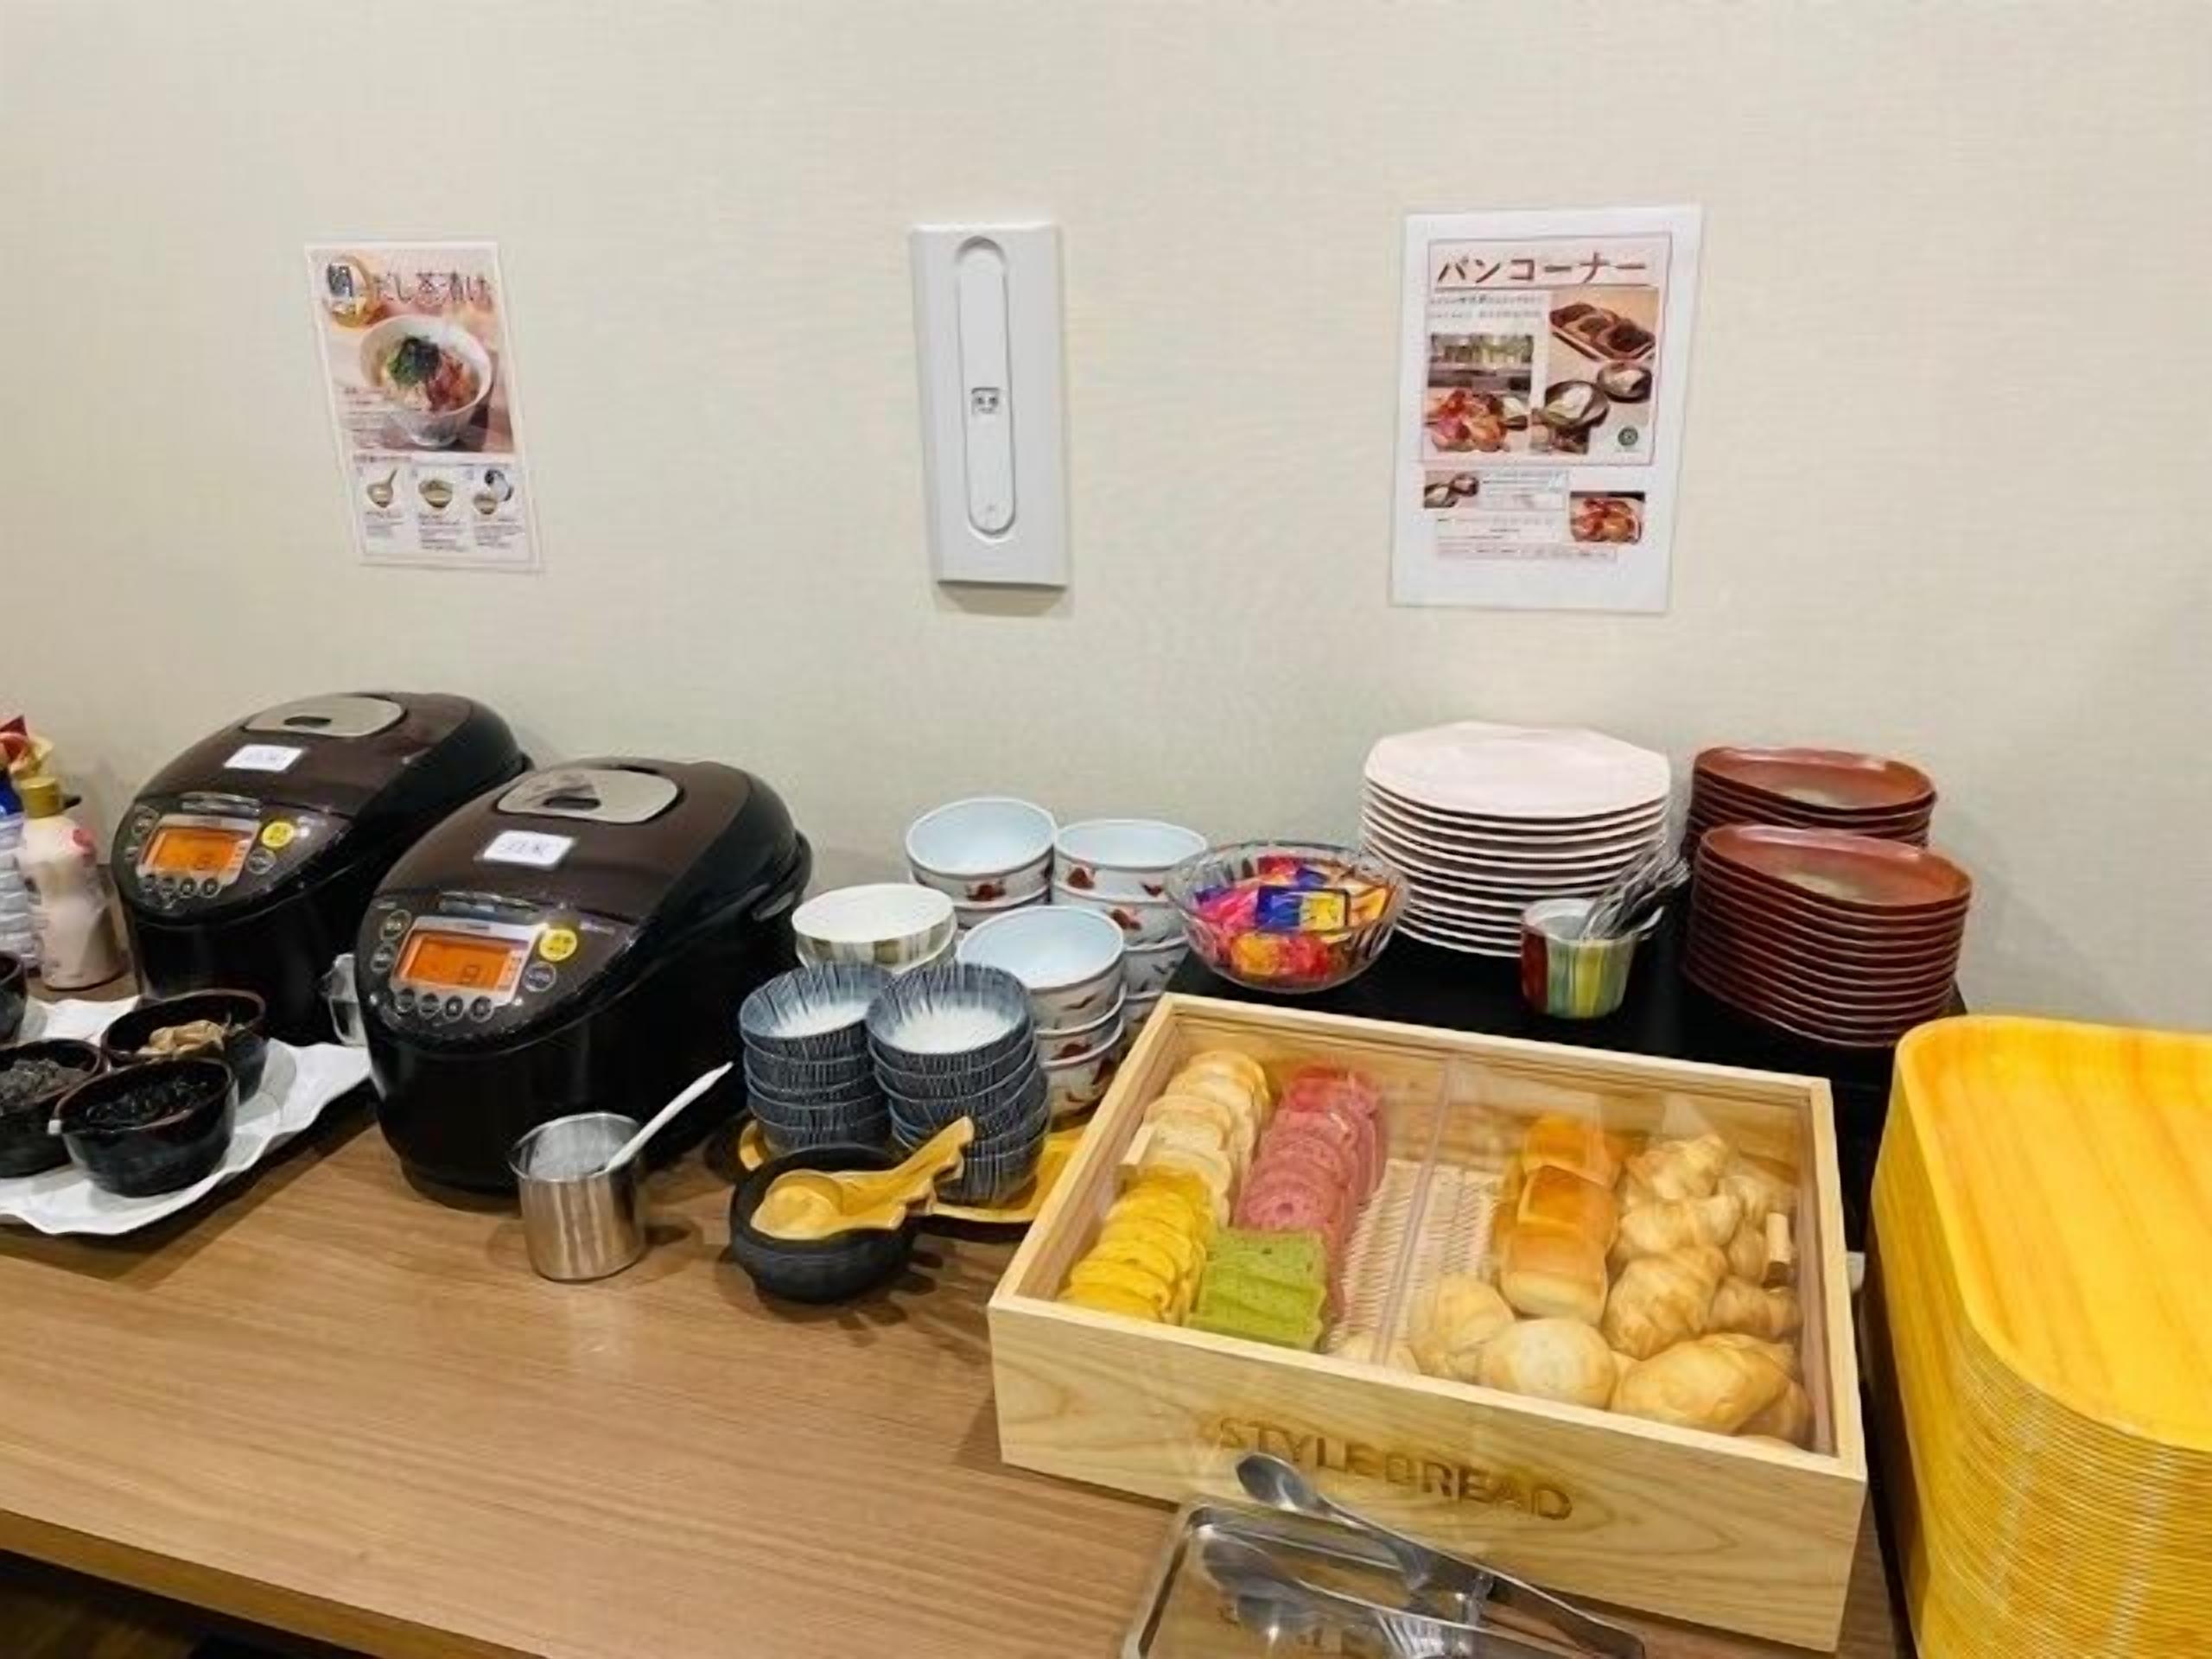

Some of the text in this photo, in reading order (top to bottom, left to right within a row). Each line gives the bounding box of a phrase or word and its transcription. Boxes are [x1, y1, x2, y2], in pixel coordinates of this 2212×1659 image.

[1437, 251, 1647, 284] パンコーナー
